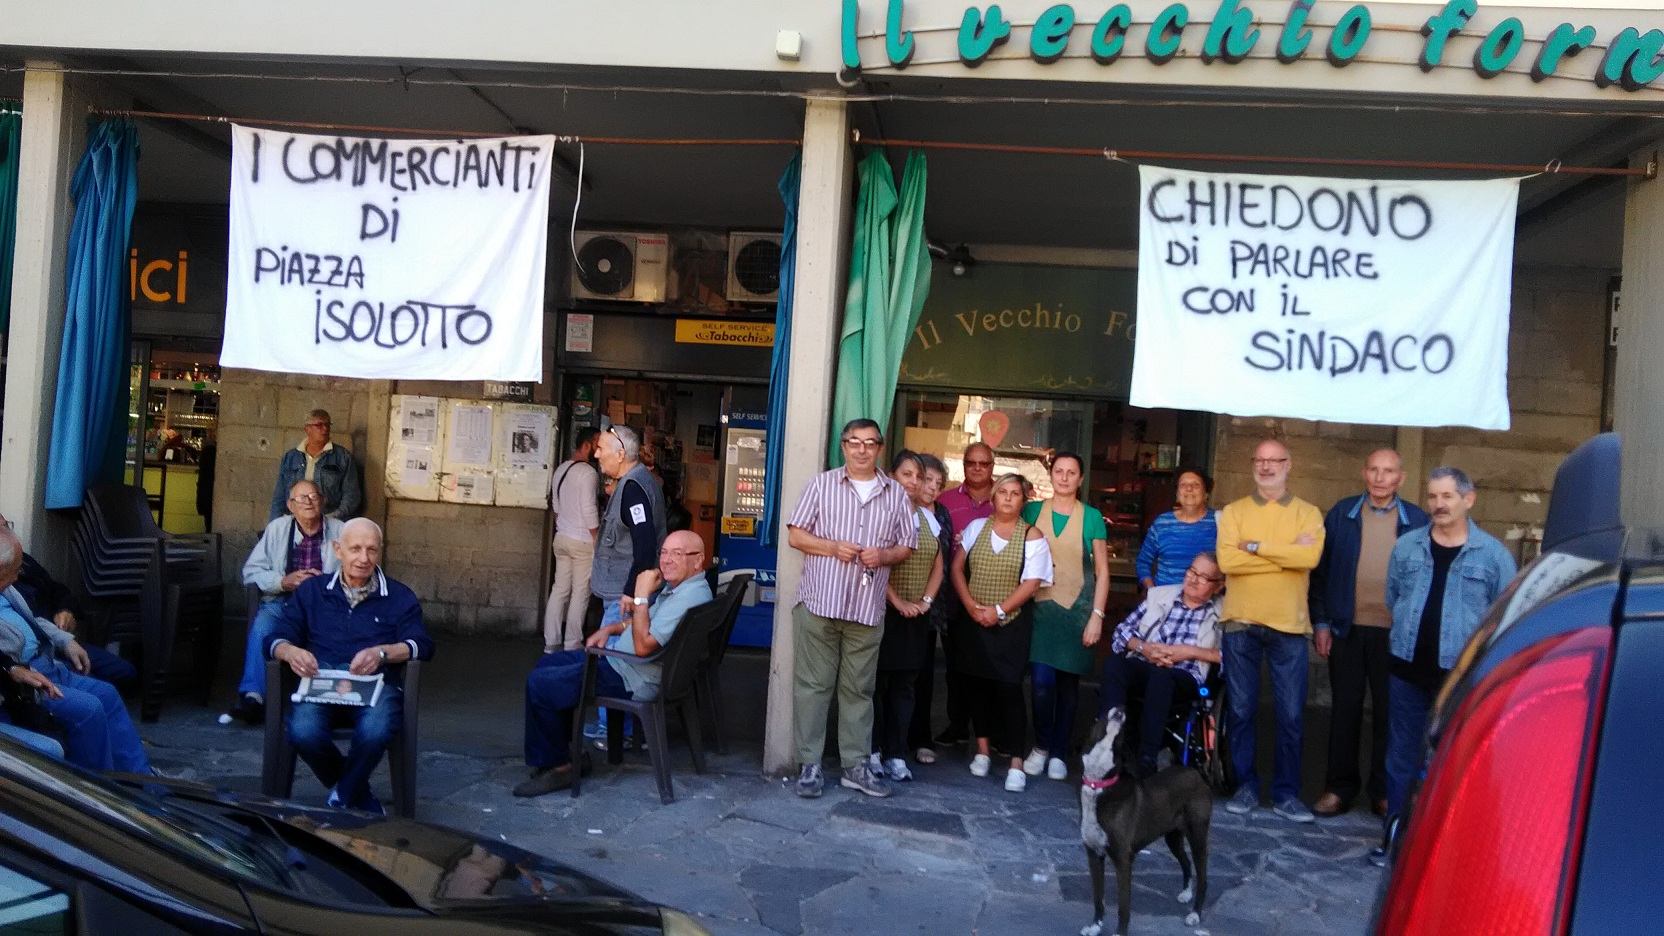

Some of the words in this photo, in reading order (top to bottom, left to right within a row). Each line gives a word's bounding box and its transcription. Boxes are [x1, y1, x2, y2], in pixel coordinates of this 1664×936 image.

[957, 0, 1372, 68] vecchio
[251, 132, 261, 184] I
[1148, 178, 1433, 241] CHIEDONO
[1230, 239, 1380, 280] PARLARE
[1182, 286, 1255, 315] CON
[709, 331, 759, 343] Tabacchi
[728, 324, 768, 332] SERVICE
[915, 320, 943, 350] Il
[955, 303, 1082, 338] Vecchio
[487, 383, 529, 396] TABACCHI
